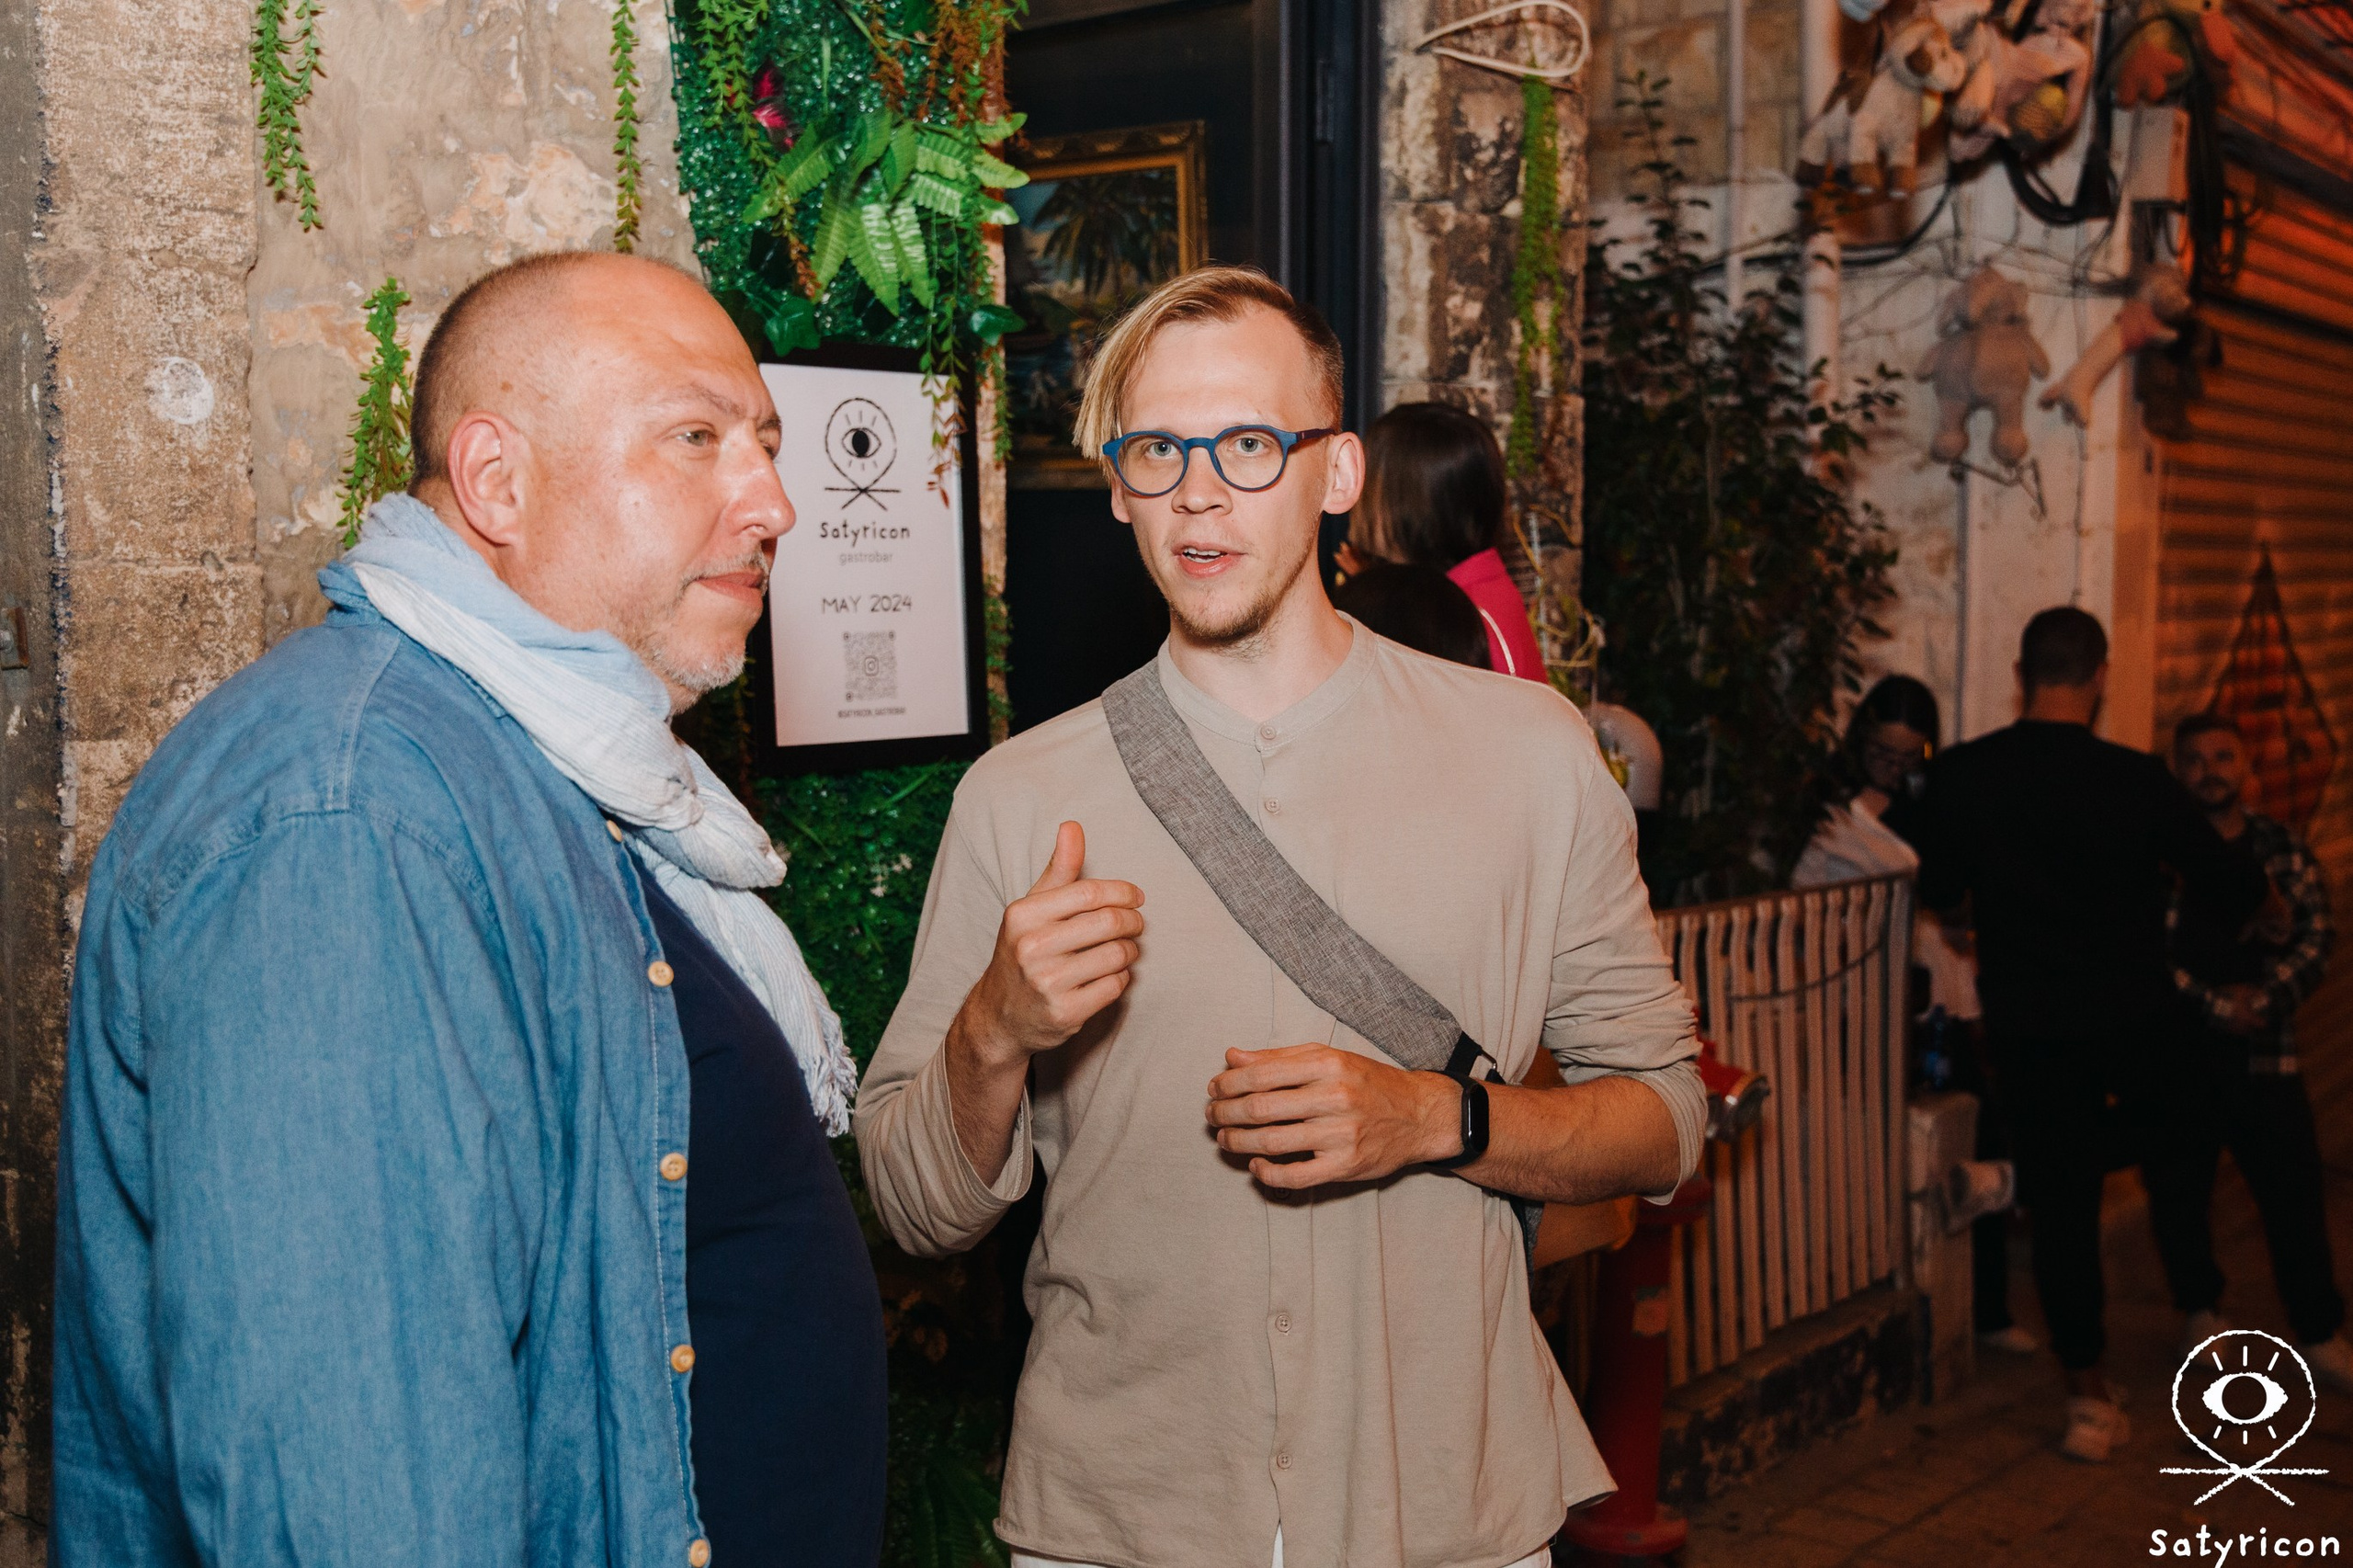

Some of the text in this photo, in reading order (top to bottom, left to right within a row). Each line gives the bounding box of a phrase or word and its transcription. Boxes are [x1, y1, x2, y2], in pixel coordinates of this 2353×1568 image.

[820, 518, 910, 547] Satyricon
[839, 551, 892, 566] gastrobar
[822, 593, 912, 614] MAY 2024
